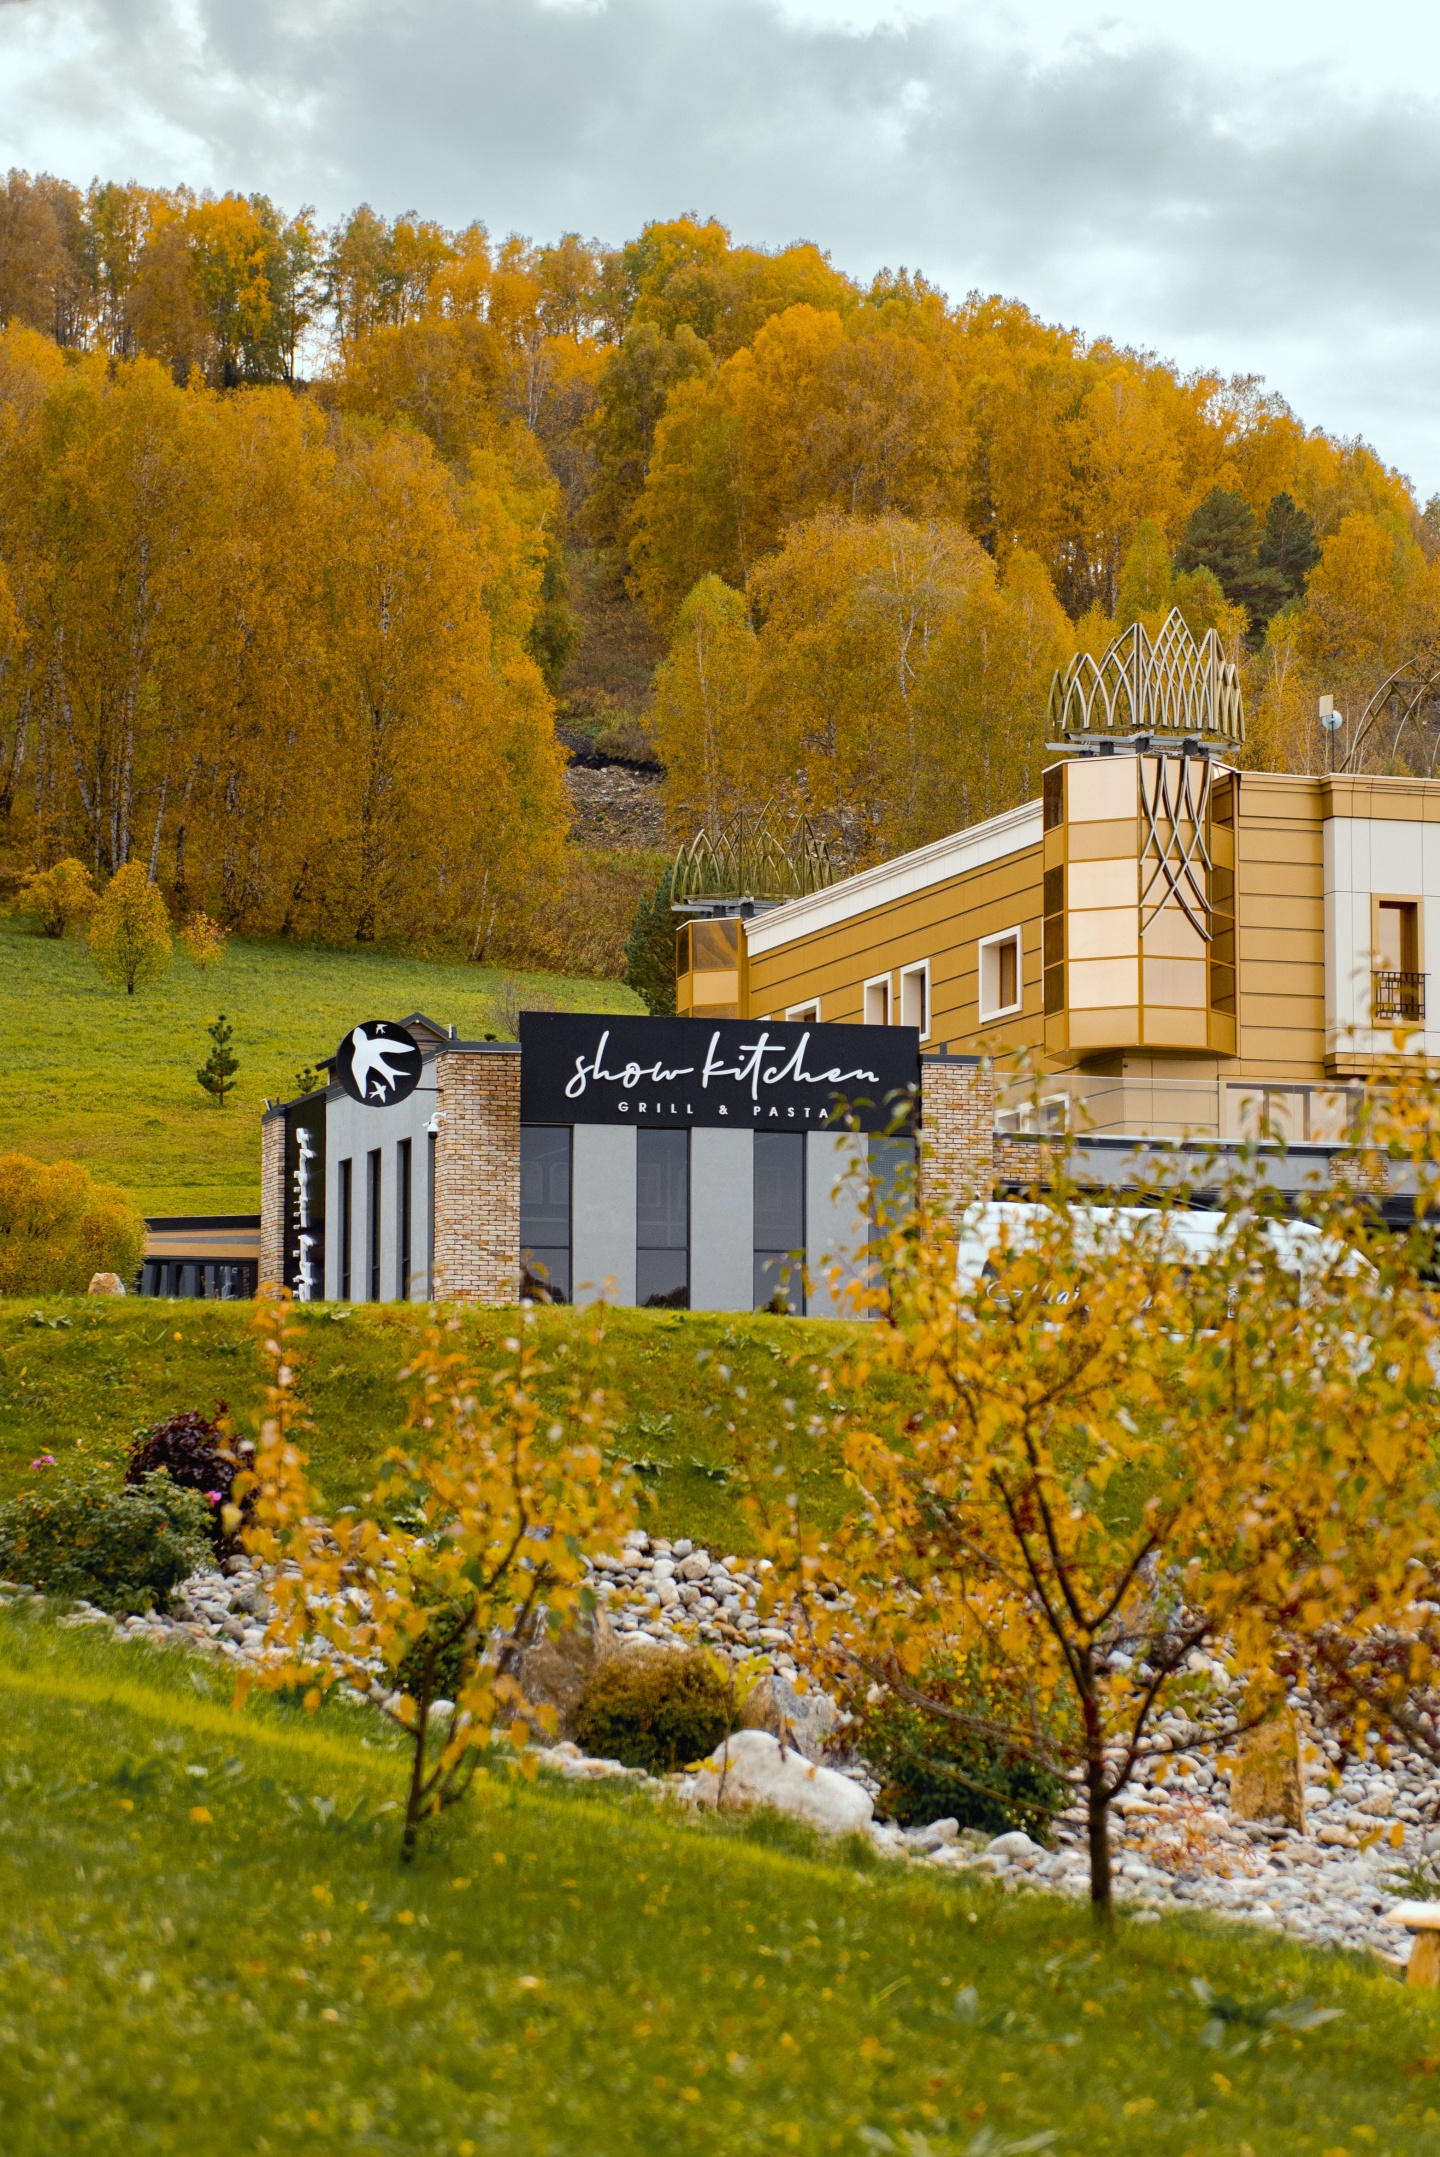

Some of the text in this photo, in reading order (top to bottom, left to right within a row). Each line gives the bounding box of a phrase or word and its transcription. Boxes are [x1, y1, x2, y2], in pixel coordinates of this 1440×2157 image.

[564, 1030, 880, 1101] show kitchen
[617, 1101, 829, 1119] GRILL & PASTA
